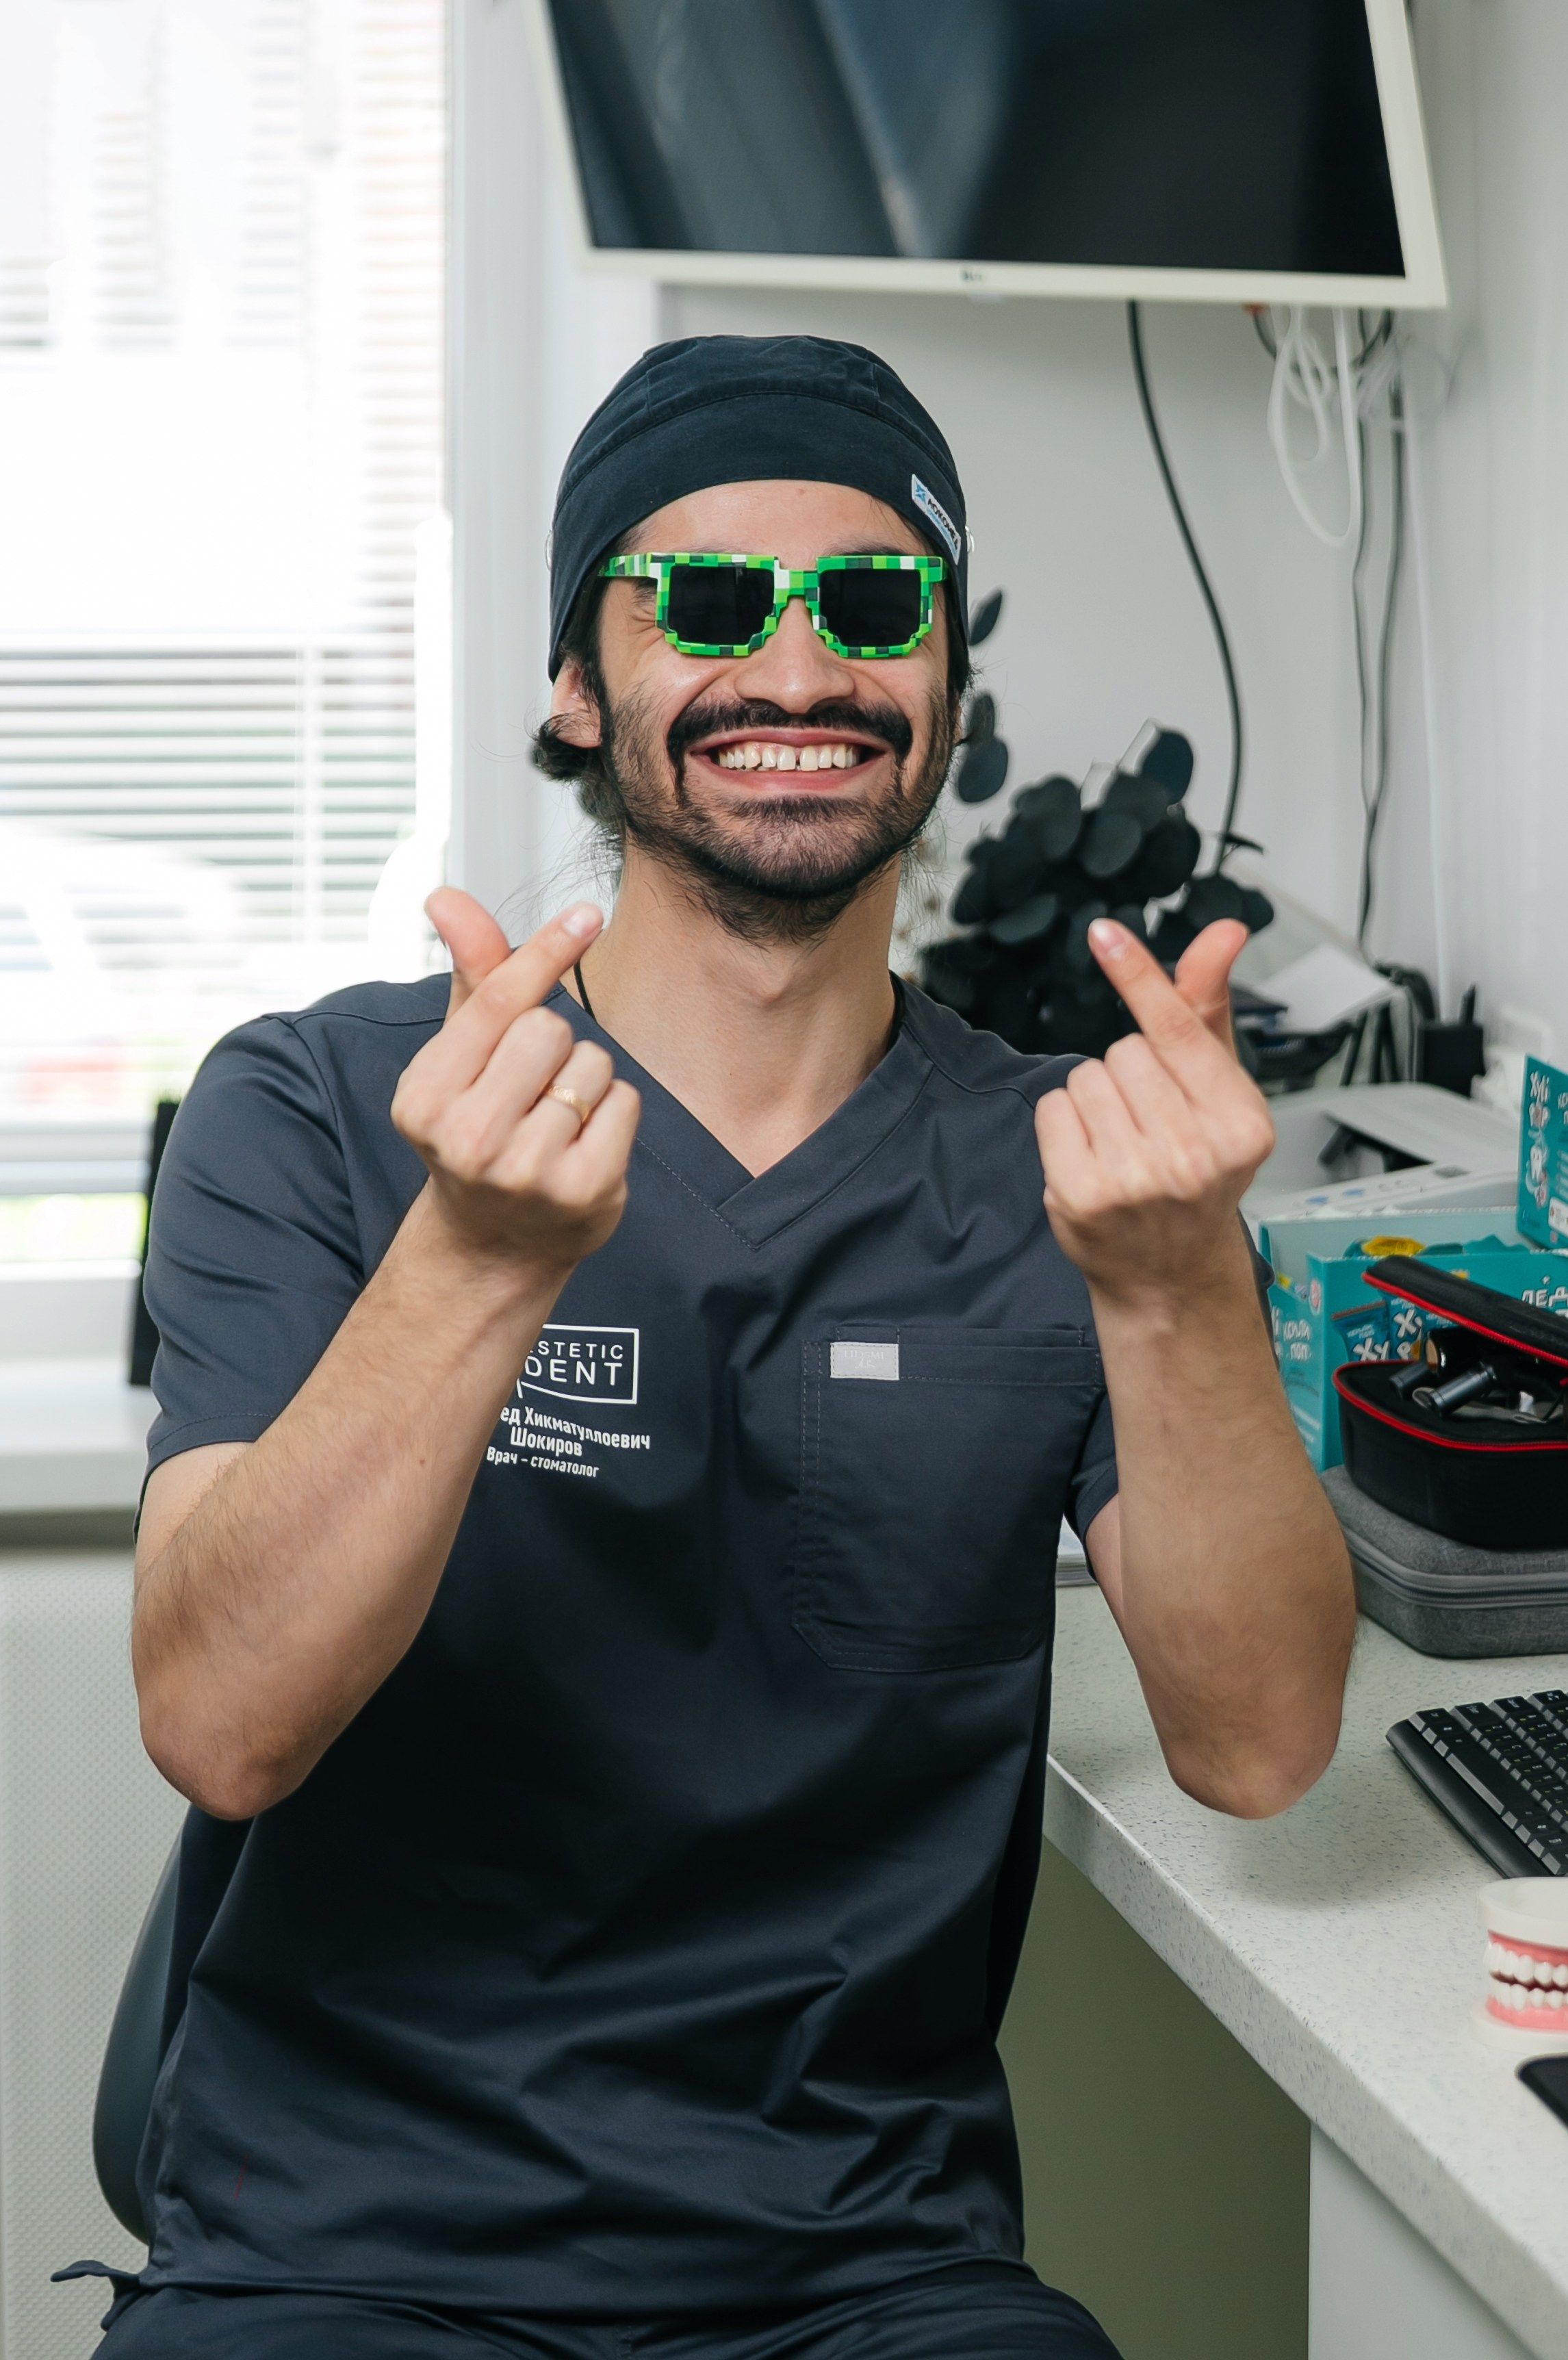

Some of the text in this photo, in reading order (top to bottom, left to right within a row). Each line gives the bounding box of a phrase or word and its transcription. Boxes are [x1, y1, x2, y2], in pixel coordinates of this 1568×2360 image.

[530, 1340, 624, 1360] STETIC
[524, 1355, 623, 1386] DENT
[500, 1406, 651, 1450] ед Хикматуллоевич
[510, 1426, 583, 1457] Шокиров
[486, 1446, 518, 1465] Врач
[530, 1455, 600, 1478] стоматолог
